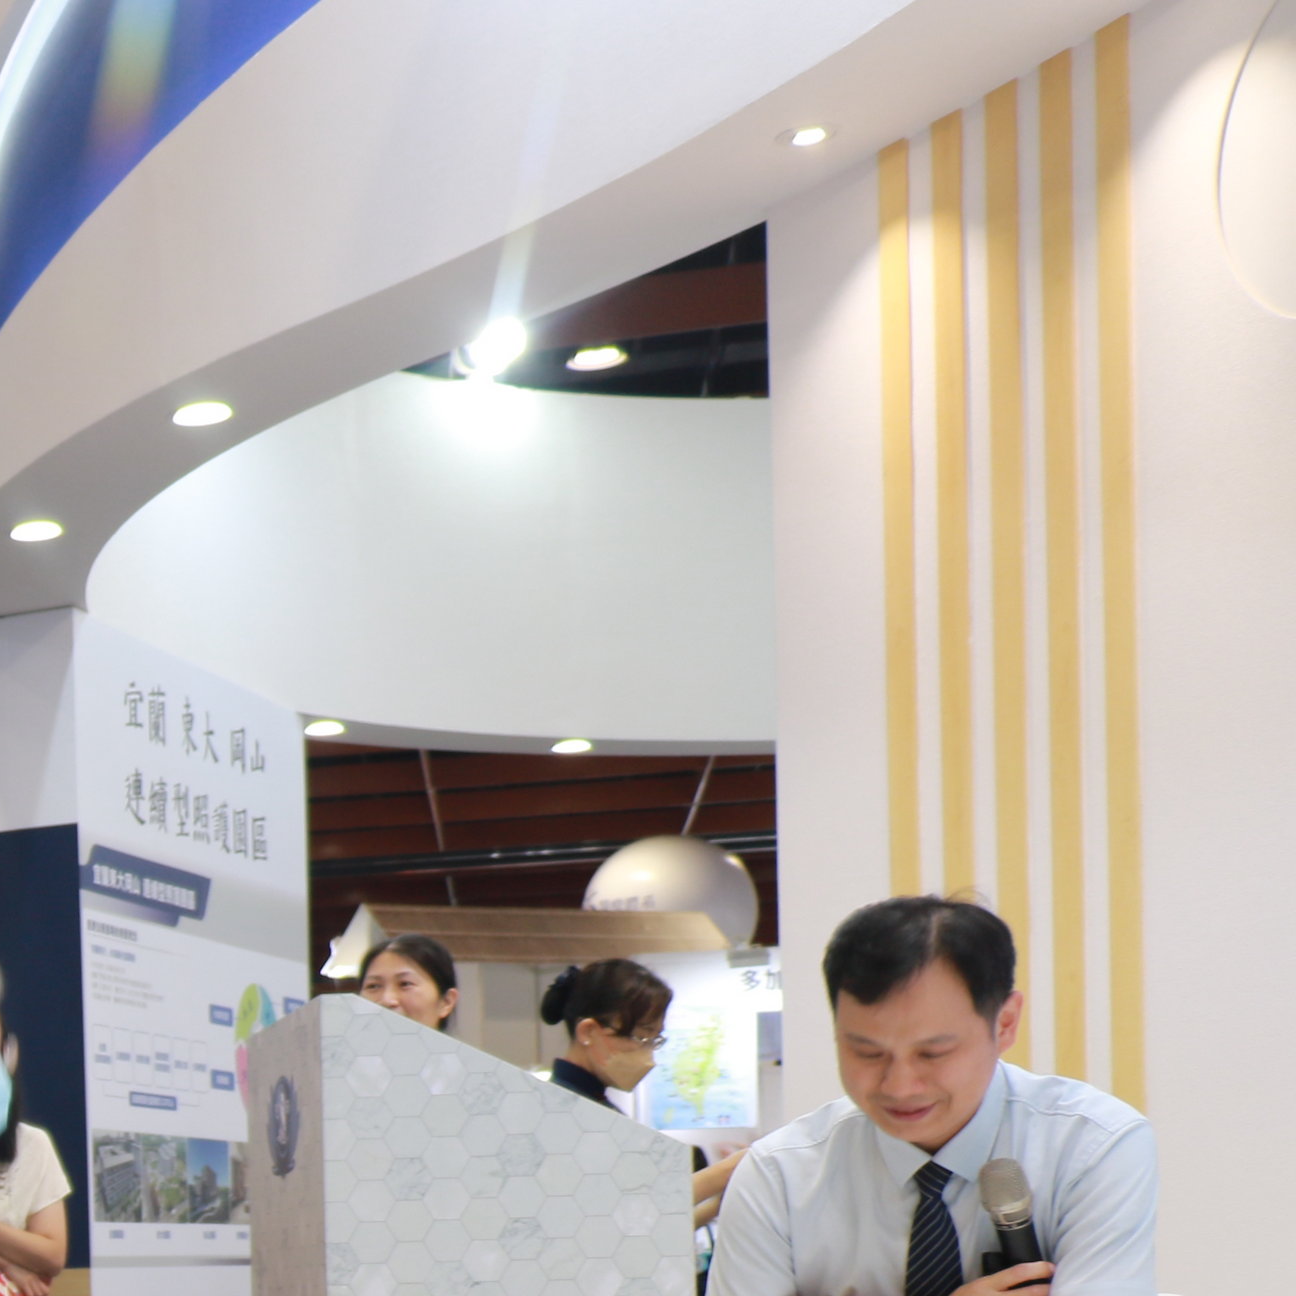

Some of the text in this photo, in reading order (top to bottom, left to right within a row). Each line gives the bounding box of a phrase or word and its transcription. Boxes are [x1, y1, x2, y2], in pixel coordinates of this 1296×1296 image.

[124, 767, 268, 861] 連續型照護園區
